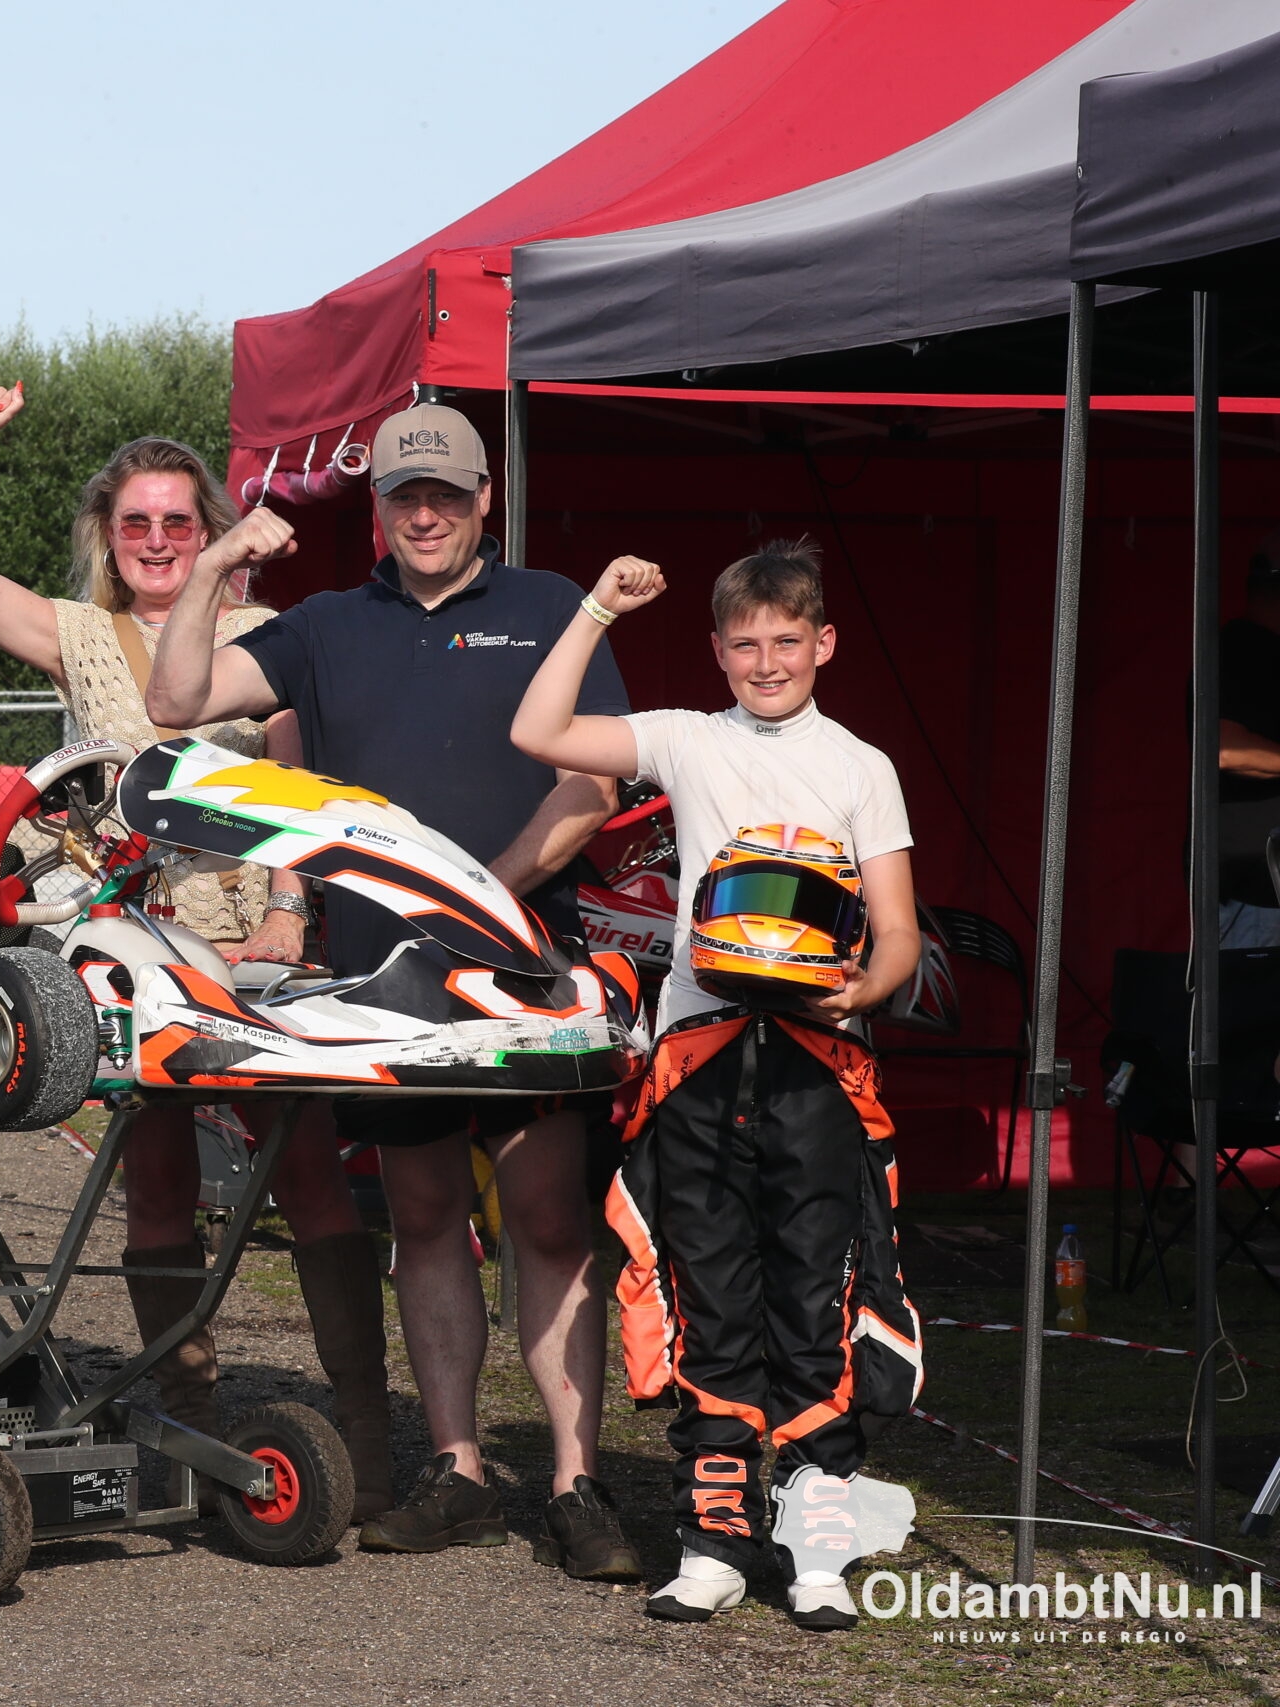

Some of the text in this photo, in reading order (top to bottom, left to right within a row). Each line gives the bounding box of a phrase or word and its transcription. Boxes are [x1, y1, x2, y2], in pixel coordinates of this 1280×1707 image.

[399, 430, 449, 451] NGK
[425, 448, 450, 456] PLUGS
[53, 745, 78, 761] TONY
[212, 817, 256, 832] PROBIO NOORD
[357, 827, 398, 845] Dijkstra
[815, 972, 841, 983] CRG
[243, 1024, 288, 1044] Kaspers
[73, 1472, 98, 1486] ENERGY
[92, 1478, 106, 1488] SAFE
